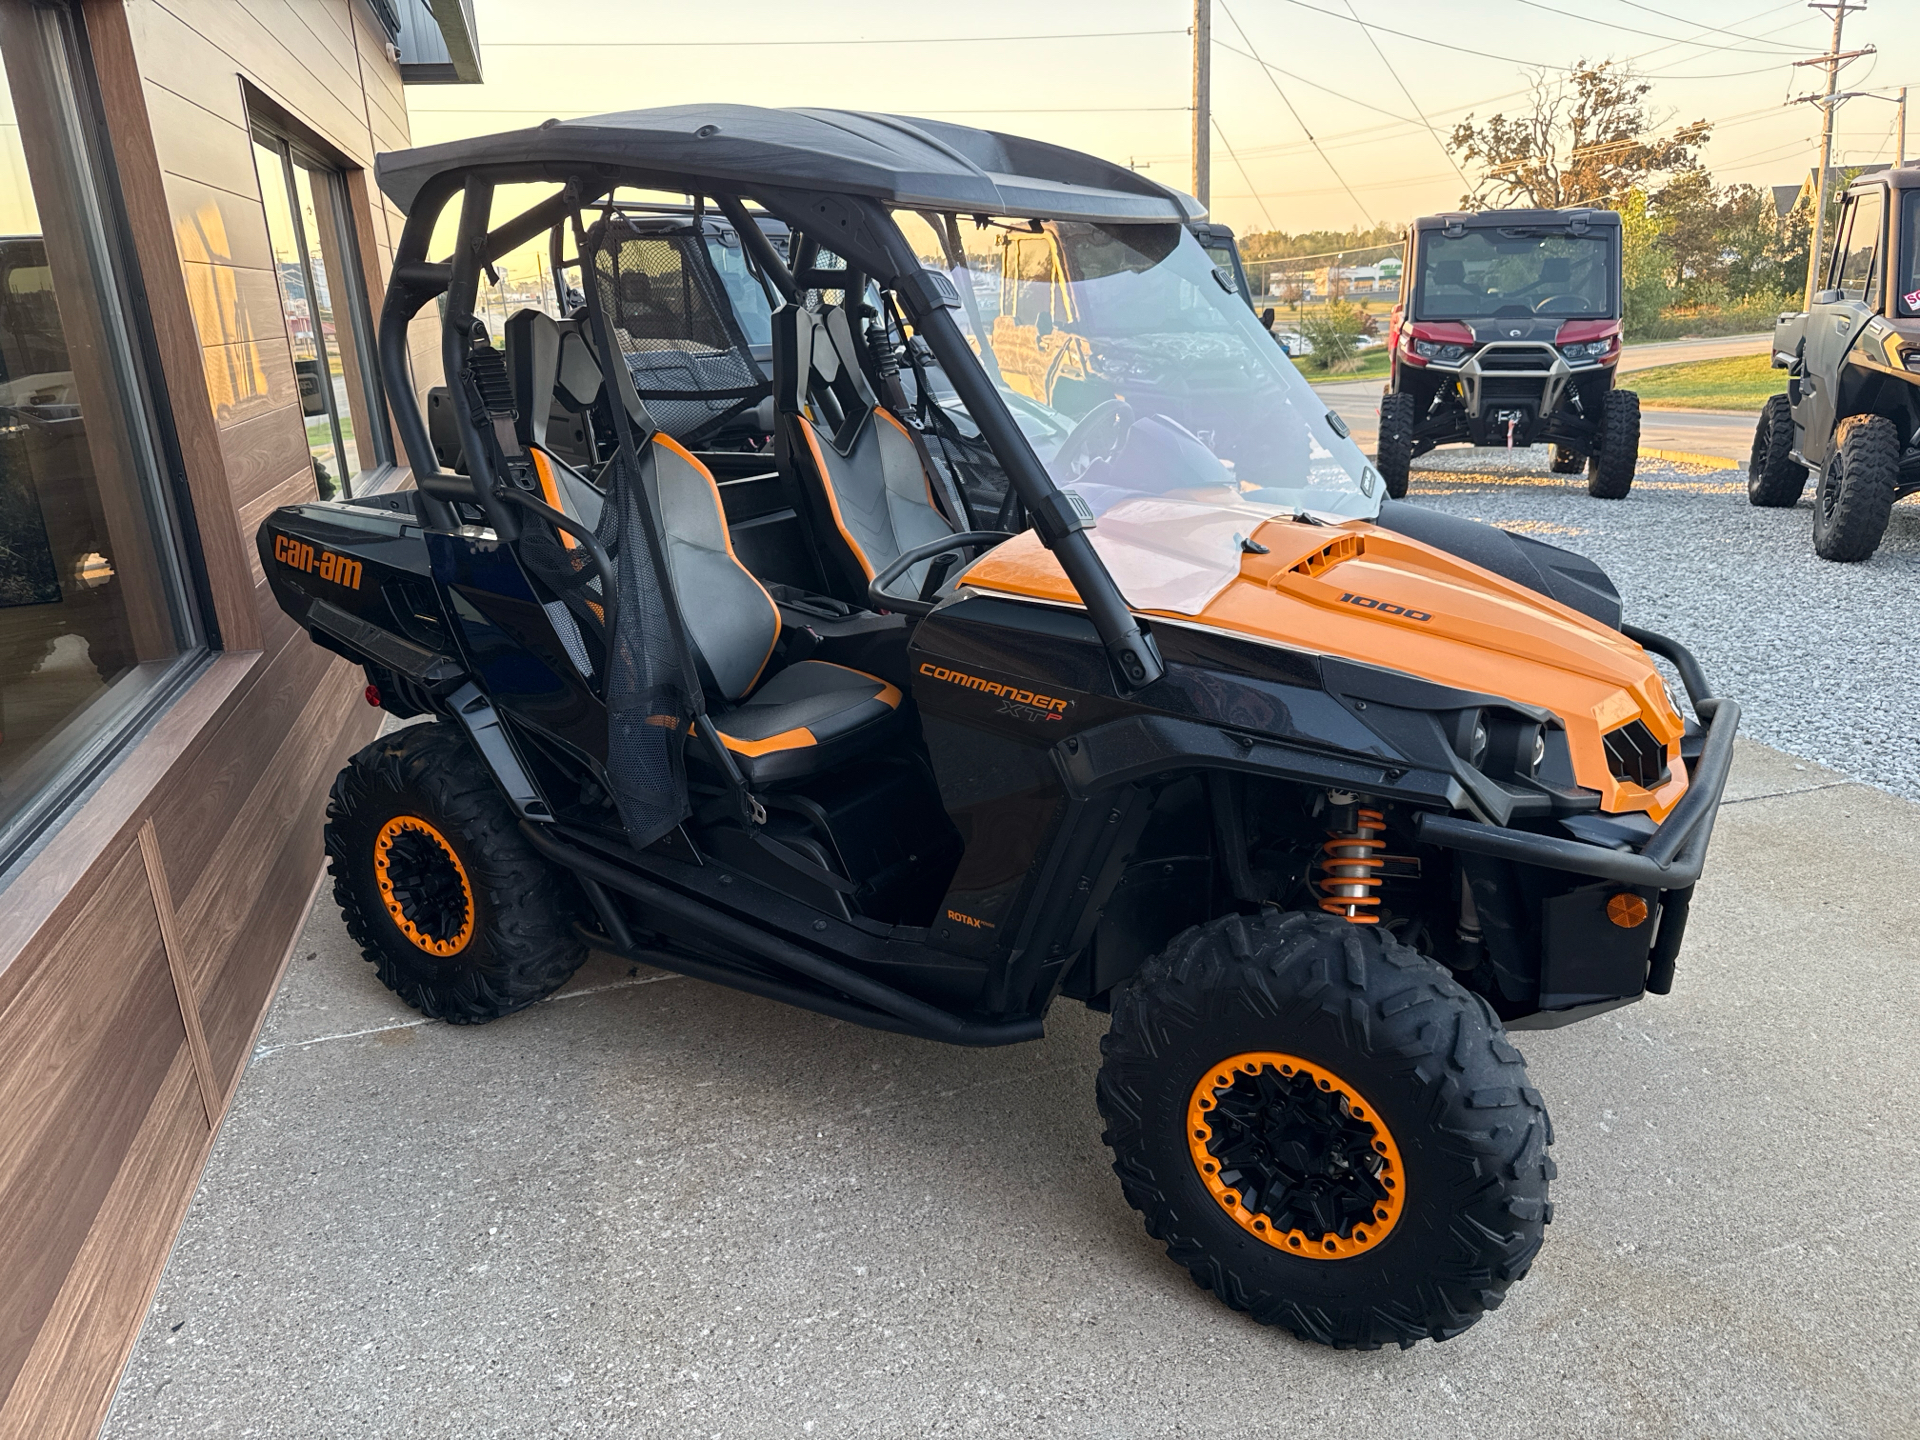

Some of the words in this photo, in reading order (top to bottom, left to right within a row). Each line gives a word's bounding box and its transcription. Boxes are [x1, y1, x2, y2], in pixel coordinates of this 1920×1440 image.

[275, 534, 362, 590] can-am
[1340, 593, 1432, 621] 1000
[919, 662, 1067, 712] COMMANDER
[997, 700, 1063, 722] XTP
[948, 910, 981, 928] ROTAX
